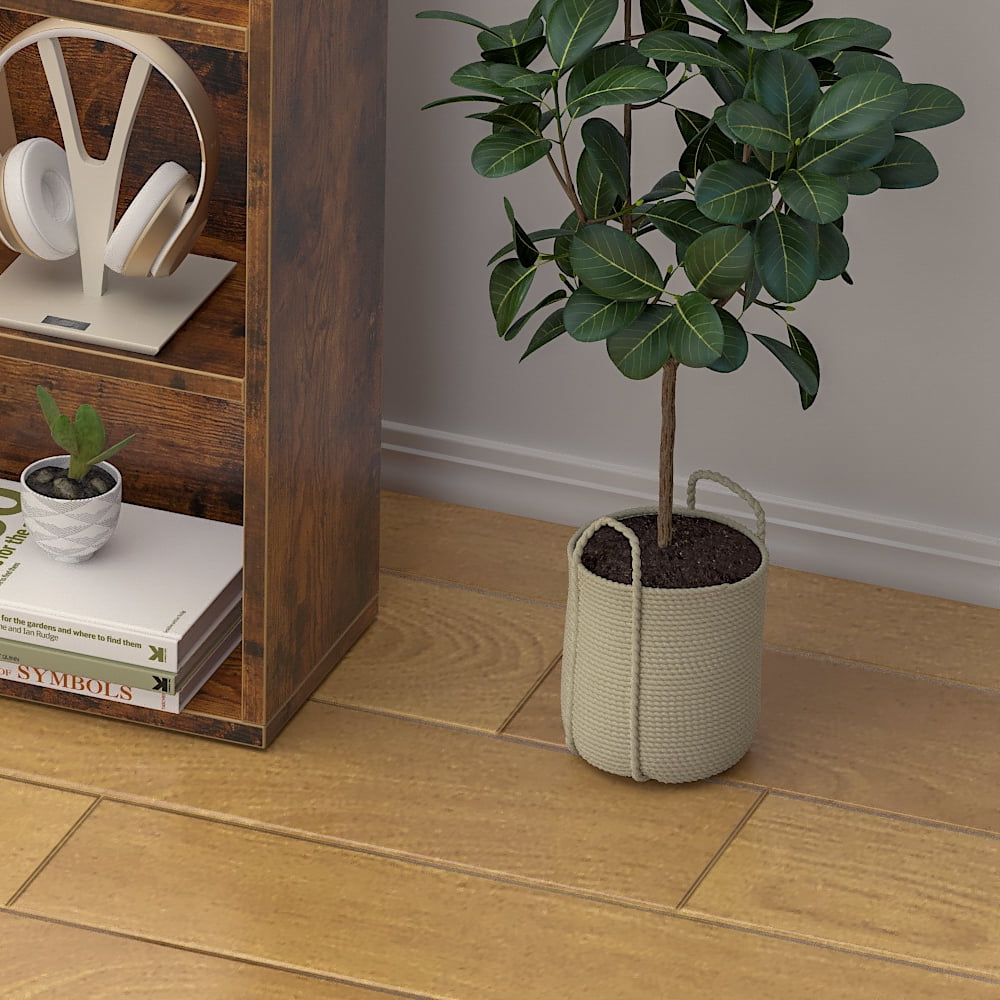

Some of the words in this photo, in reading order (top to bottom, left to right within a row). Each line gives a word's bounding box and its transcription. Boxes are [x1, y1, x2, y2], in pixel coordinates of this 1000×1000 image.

[6, 528, 31, 545] the
[1, 614, 12, 622] for
[13, 616, 26, 626] the
[26, 619, 57, 633] gardens
[57, 625, 72, 635] and
[73, 628, 96, 640] where
[97, 633, 106, 642] to
[106, 635, 122, 645] find
[123, 639, 142, 649] them
[8, 624, 22, 634] and
[23, 628, 35, 637] Ian
[36, 629, 59, 642] Rudge
[17, 663, 133, 701] SYMBOLS
